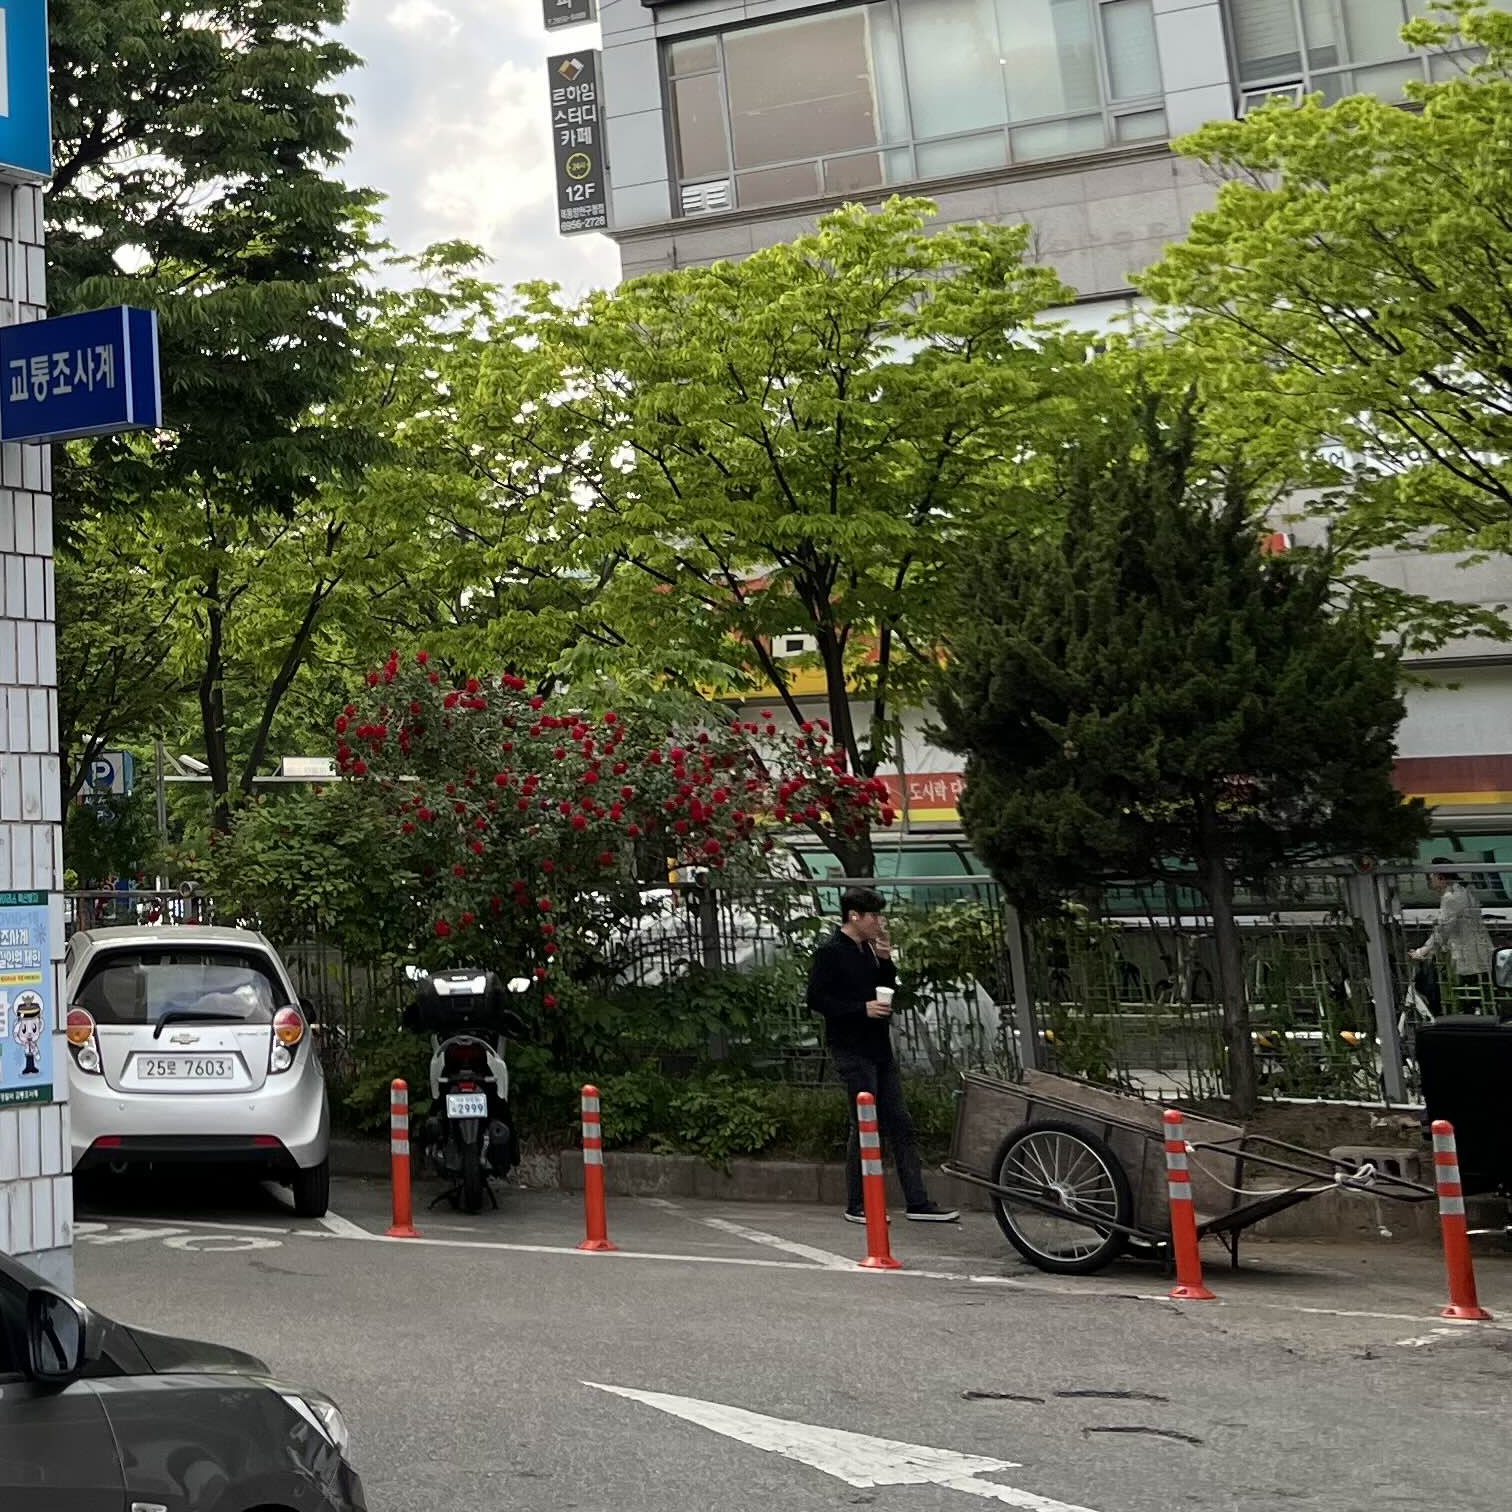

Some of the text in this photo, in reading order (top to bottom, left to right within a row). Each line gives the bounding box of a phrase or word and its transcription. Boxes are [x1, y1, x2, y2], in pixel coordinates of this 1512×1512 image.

[552, 82, 595, 107] 르하임
[554, 104, 597, 128] 스터디
[560, 125, 592, 149] 카페
[565, 182, 595, 203] 12F
[9, 343, 115, 402] 교통조사계
[909, 779, 947, 802] 도시락
[184, 1059, 226, 1077] 7603
[457, 1103, 484, 1115] 2999
